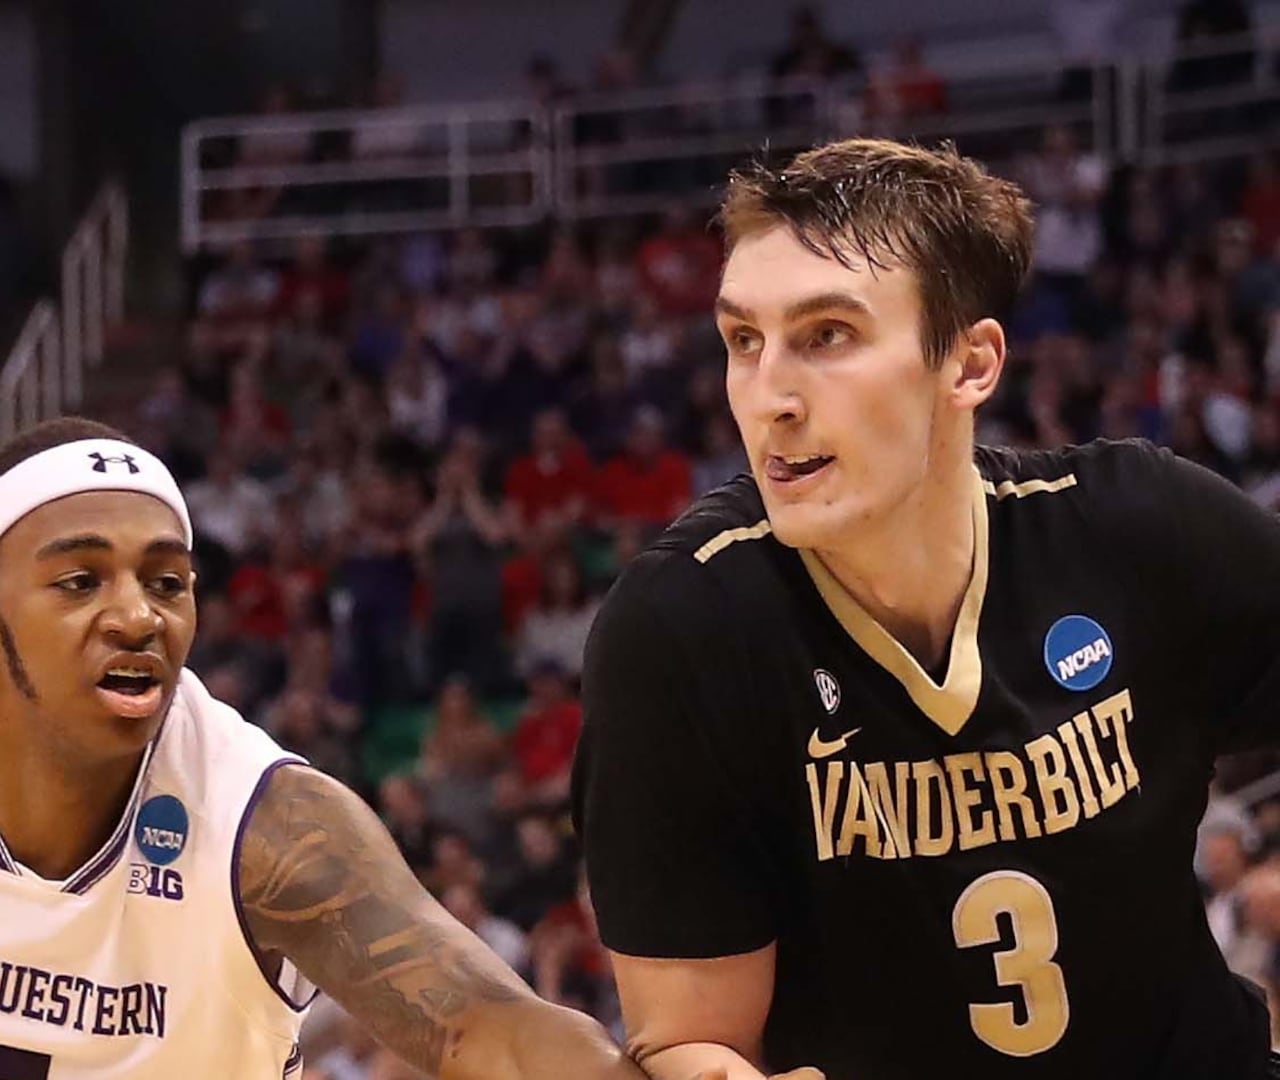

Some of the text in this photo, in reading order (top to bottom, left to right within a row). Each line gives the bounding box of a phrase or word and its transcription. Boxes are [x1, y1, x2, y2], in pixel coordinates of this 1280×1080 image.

[1057, 638, 1111, 681] NCAA
[805, 688, 1141, 862] VANDERBILT
[142, 826, 183, 851] NCAA
[952, 870, 1070, 1057] 3
